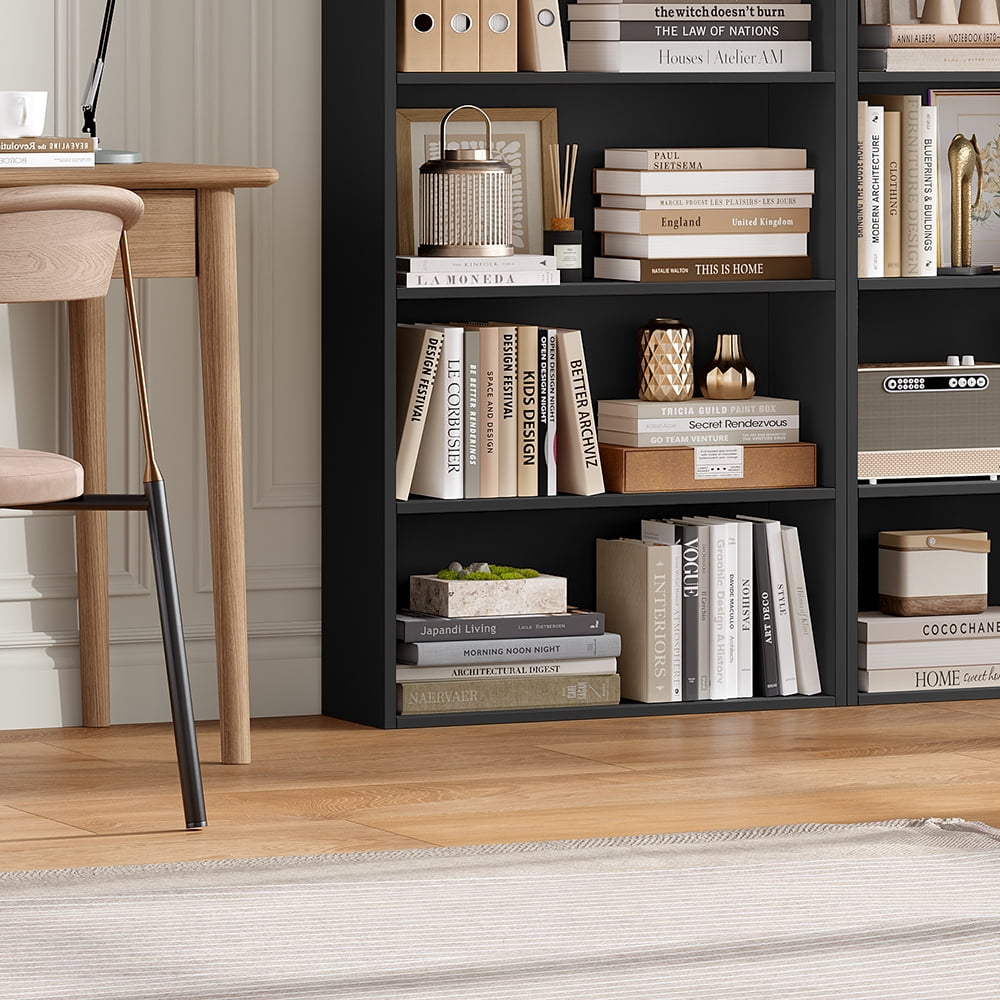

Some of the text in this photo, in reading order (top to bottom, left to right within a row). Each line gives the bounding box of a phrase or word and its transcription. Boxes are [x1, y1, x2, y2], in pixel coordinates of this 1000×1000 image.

[655, 26, 779, 36] THE LAW OF NATIONS
[897, 34, 936, 43] ANNI ALBERS
[659, 49, 783, 64] Houses Atelier AM
[654, 152, 679, 160] PAUL
[872, 134, 880, 243] MODERN ARCHITECTURE
[888, 161, 897, 216] CLOTHING
[661, 217, 701, 229] England
[732, 218, 793, 228] United Kingdom
[695, 263, 763, 275] THIS IS HOME
[418, 274, 515, 285] LA MONEDA
[411, 337, 438, 422] DESIGN FESTIVAL
[504, 334, 512, 420] DESIGN FESTIVAL
[448, 360, 460, 473] LE CORBUSIER
[524, 371, 535, 465] KIDS DESIGN
[570, 359, 598, 469] BETTER ARCHVIZ
[689, 419, 788, 429] Secret Rendezvous
[691, 435, 729, 443] VENTURE
[683, 538, 699, 598] VOGUE
[742, 579, 750, 631] FASHION
[777, 584, 787, 616] STYLE
[654, 574, 666, 678] INTERIORS
[762, 591, 772, 645] ART DECO
[420, 624, 497, 637] Japandi Living
[464, 645, 561, 657] MORNING NOON NIGHT
[452, 665, 561, 676] ARCHITECTURAL DIGEST
[915, 670, 960, 688] HOME
[964, 670, 986, 682] sweet
